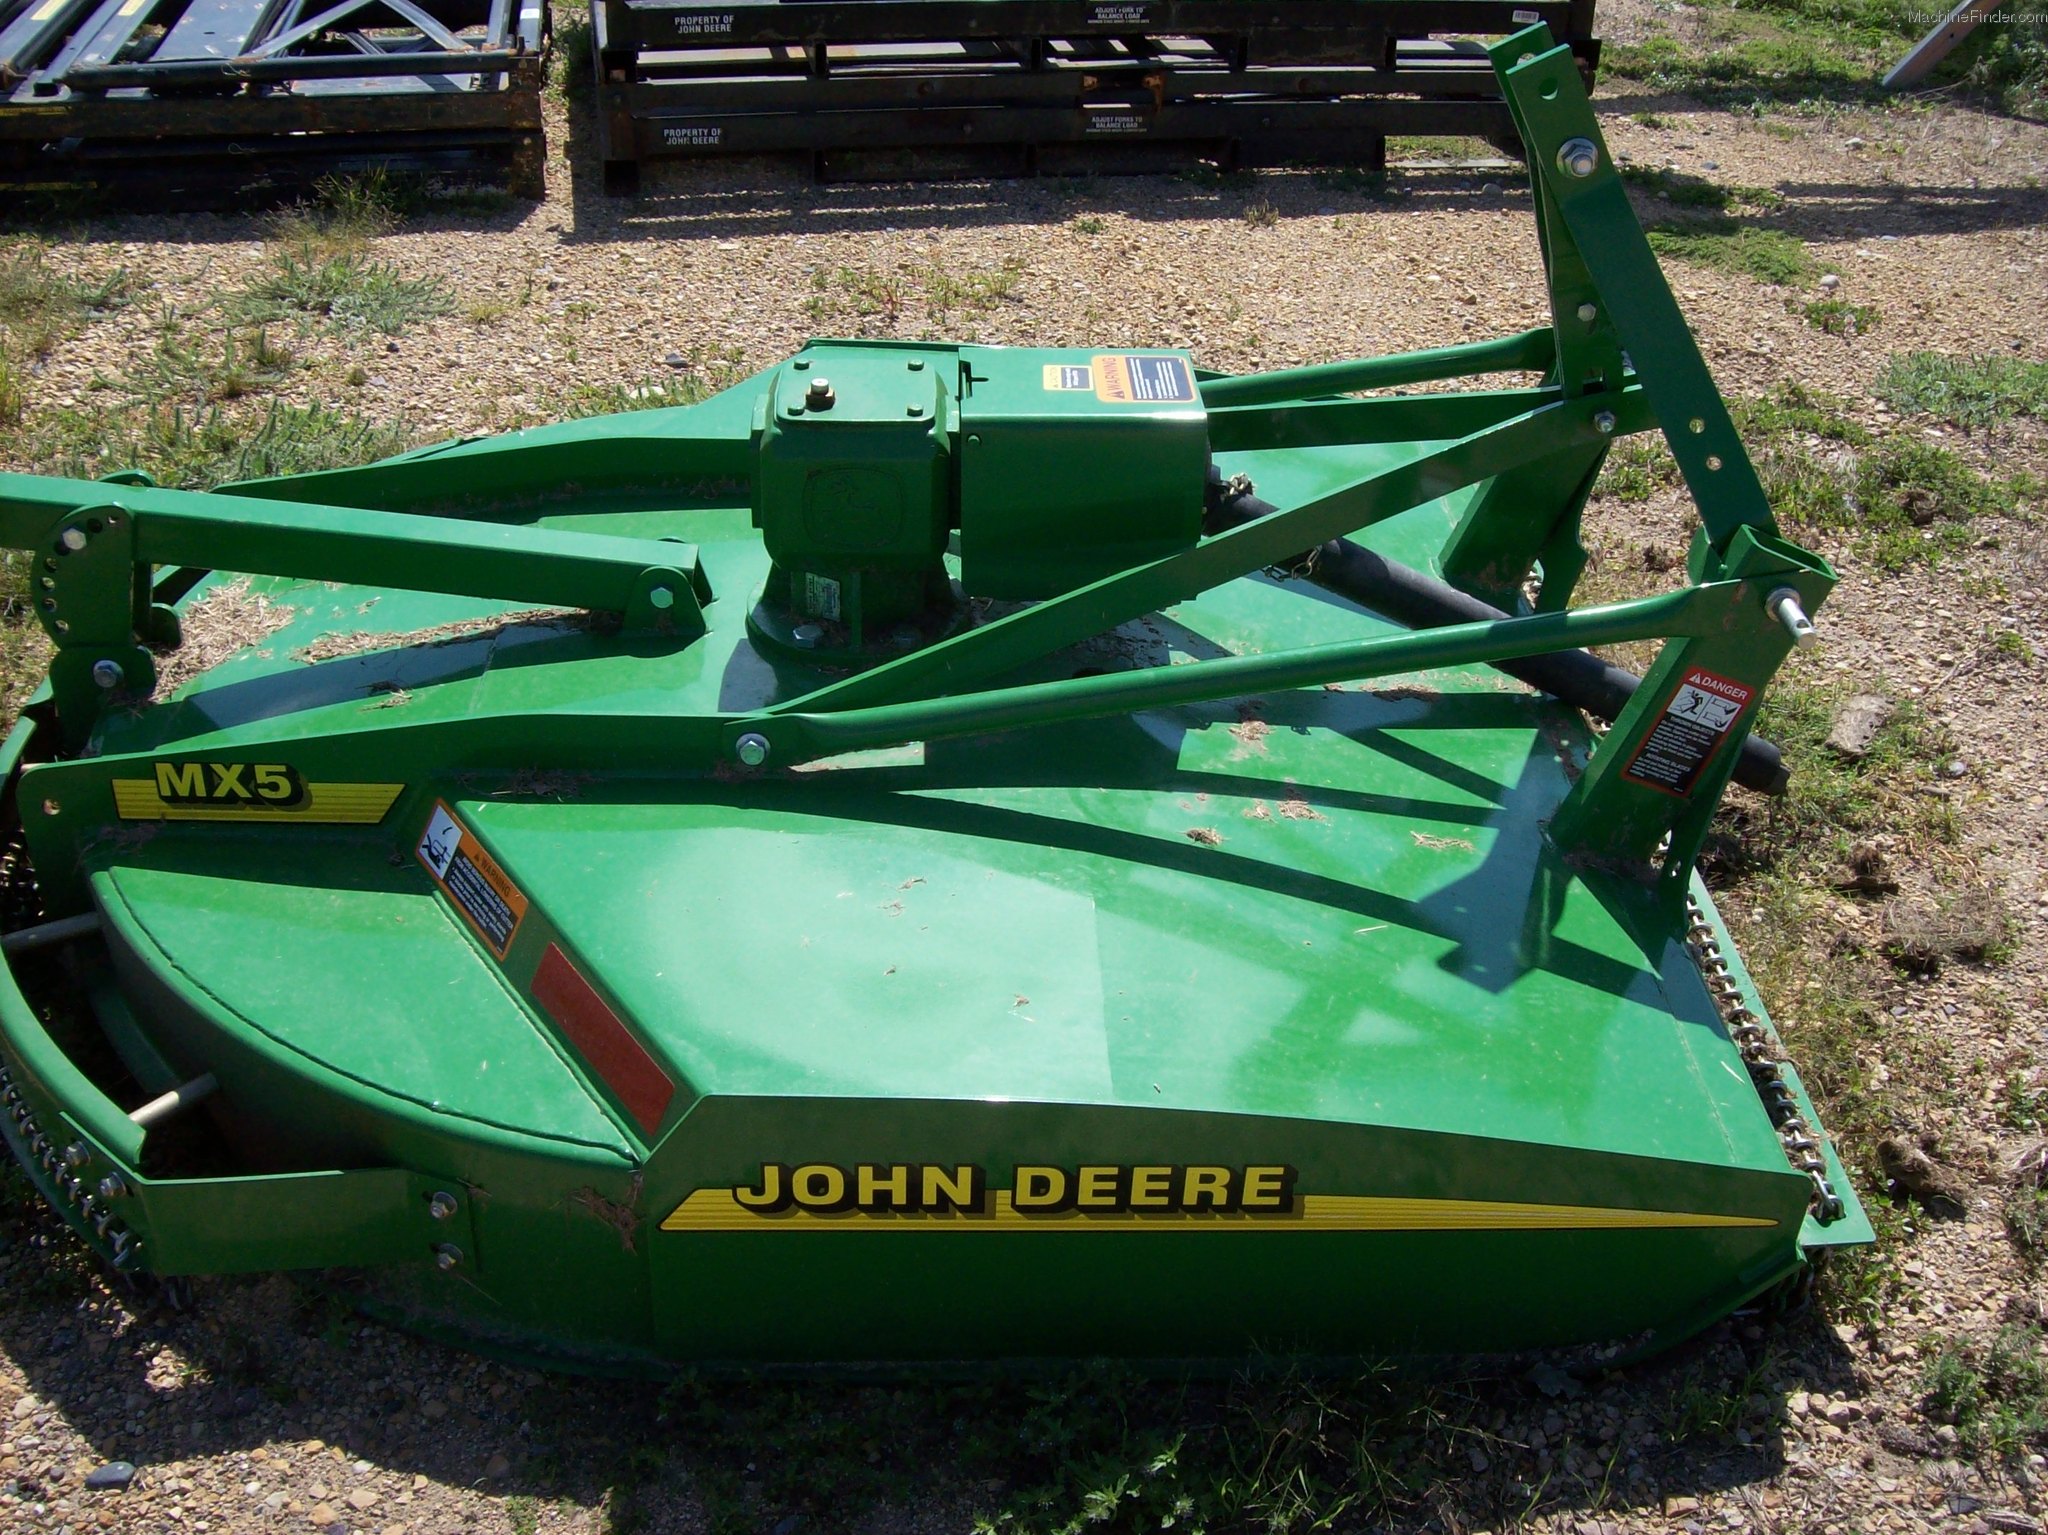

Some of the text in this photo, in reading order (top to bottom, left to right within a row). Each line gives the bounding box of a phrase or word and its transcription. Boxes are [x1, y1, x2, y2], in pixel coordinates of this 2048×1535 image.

[674, 15, 735, 26] PROPERTY OF
[678, 23, 732, 34] JOHN DEERE
[663, 128, 722, 137] PROPERTY OF
[692, 136, 720, 145] DEERE
[1102, 357, 1121, 391] WARNING
[1701, 676, 1748, 700] DANGER
[154, 762, 294, 801] MX5
[479, 855, 511, 897] WARNING
[735, 1163, 1289, 1208] JOHN DEERE
